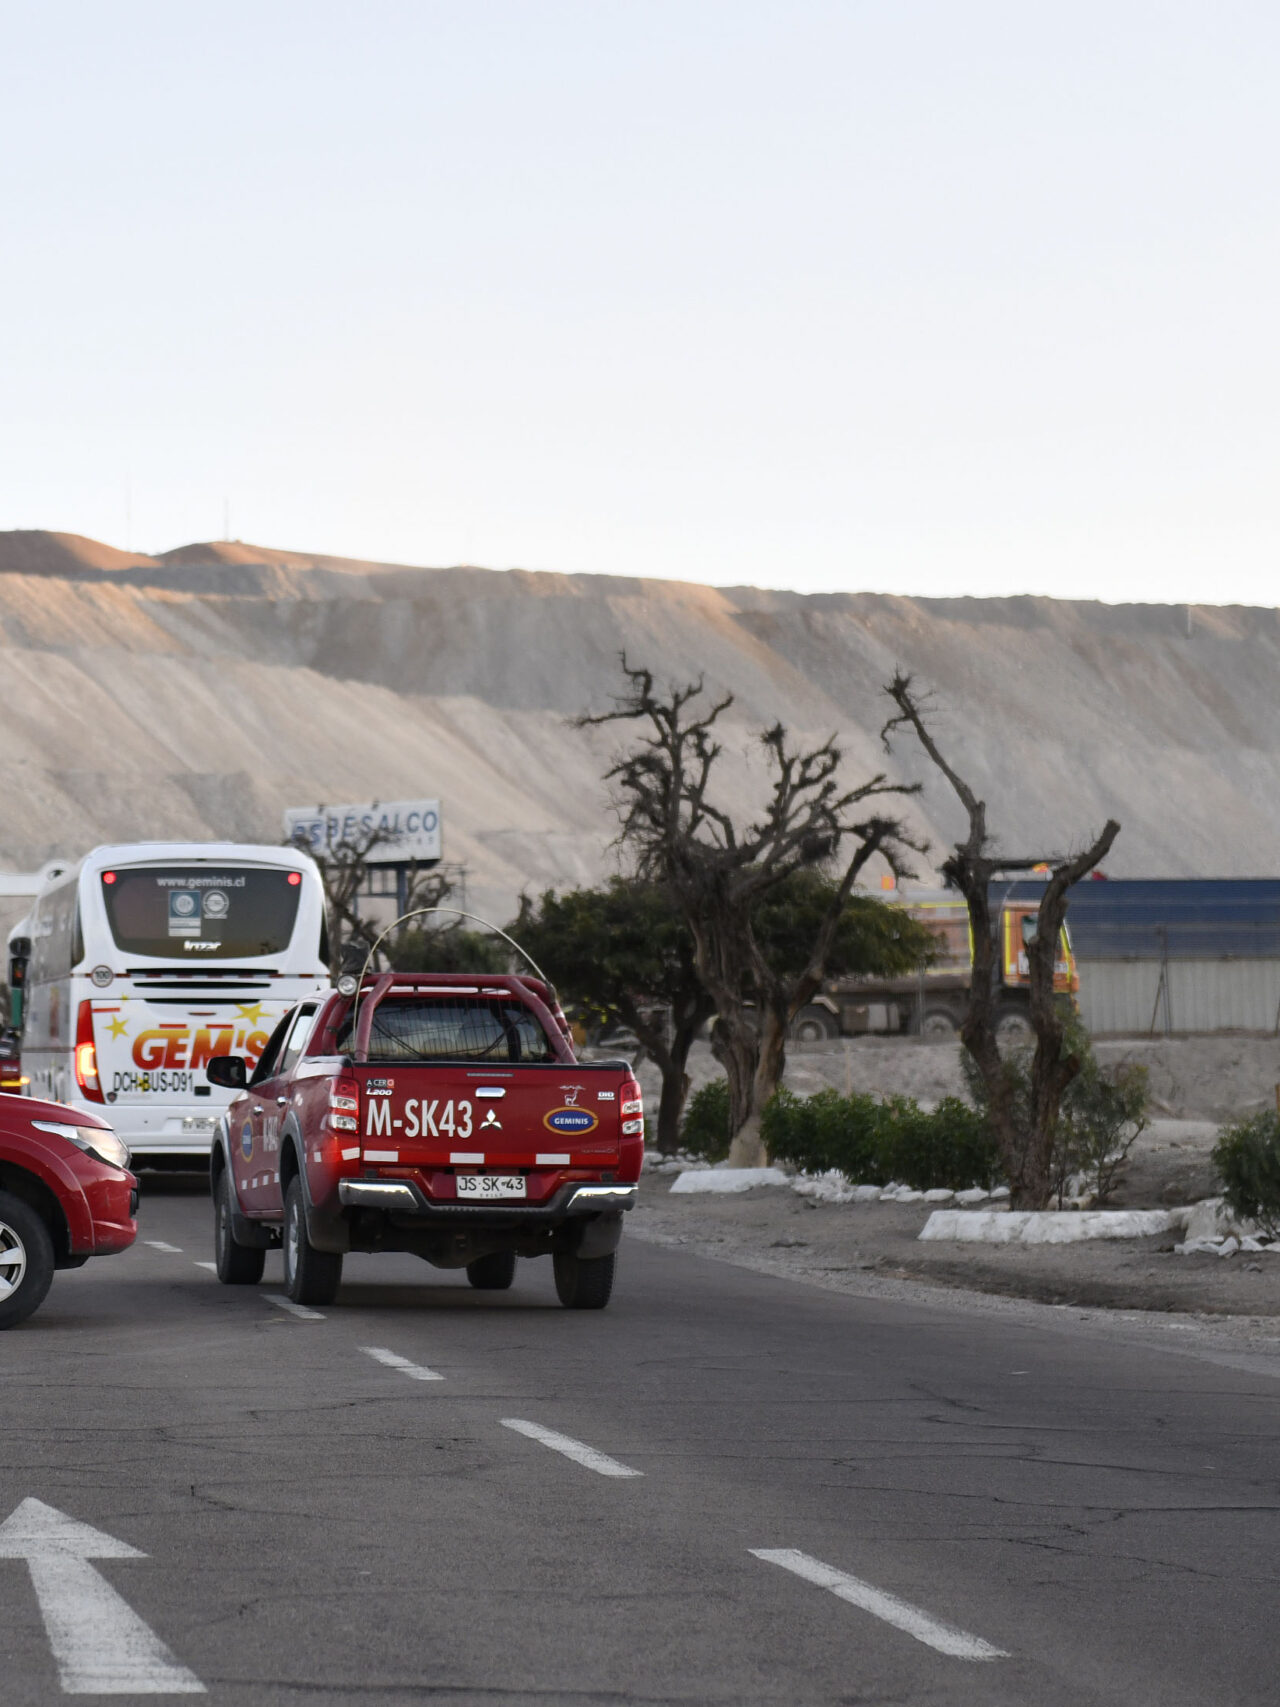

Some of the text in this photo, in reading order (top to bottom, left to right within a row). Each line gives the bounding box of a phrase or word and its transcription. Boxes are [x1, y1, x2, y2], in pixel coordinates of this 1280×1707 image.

[157, 876, 246, 888] www.geminis.cl
[113, 1071, 193, 1093] DCH-BUS-D91
[366, 1088, 393, 1096] L200
[365, 1098, 473, 1139] M-SK43
[554, 1117, 589, 1125] GEMINIS
